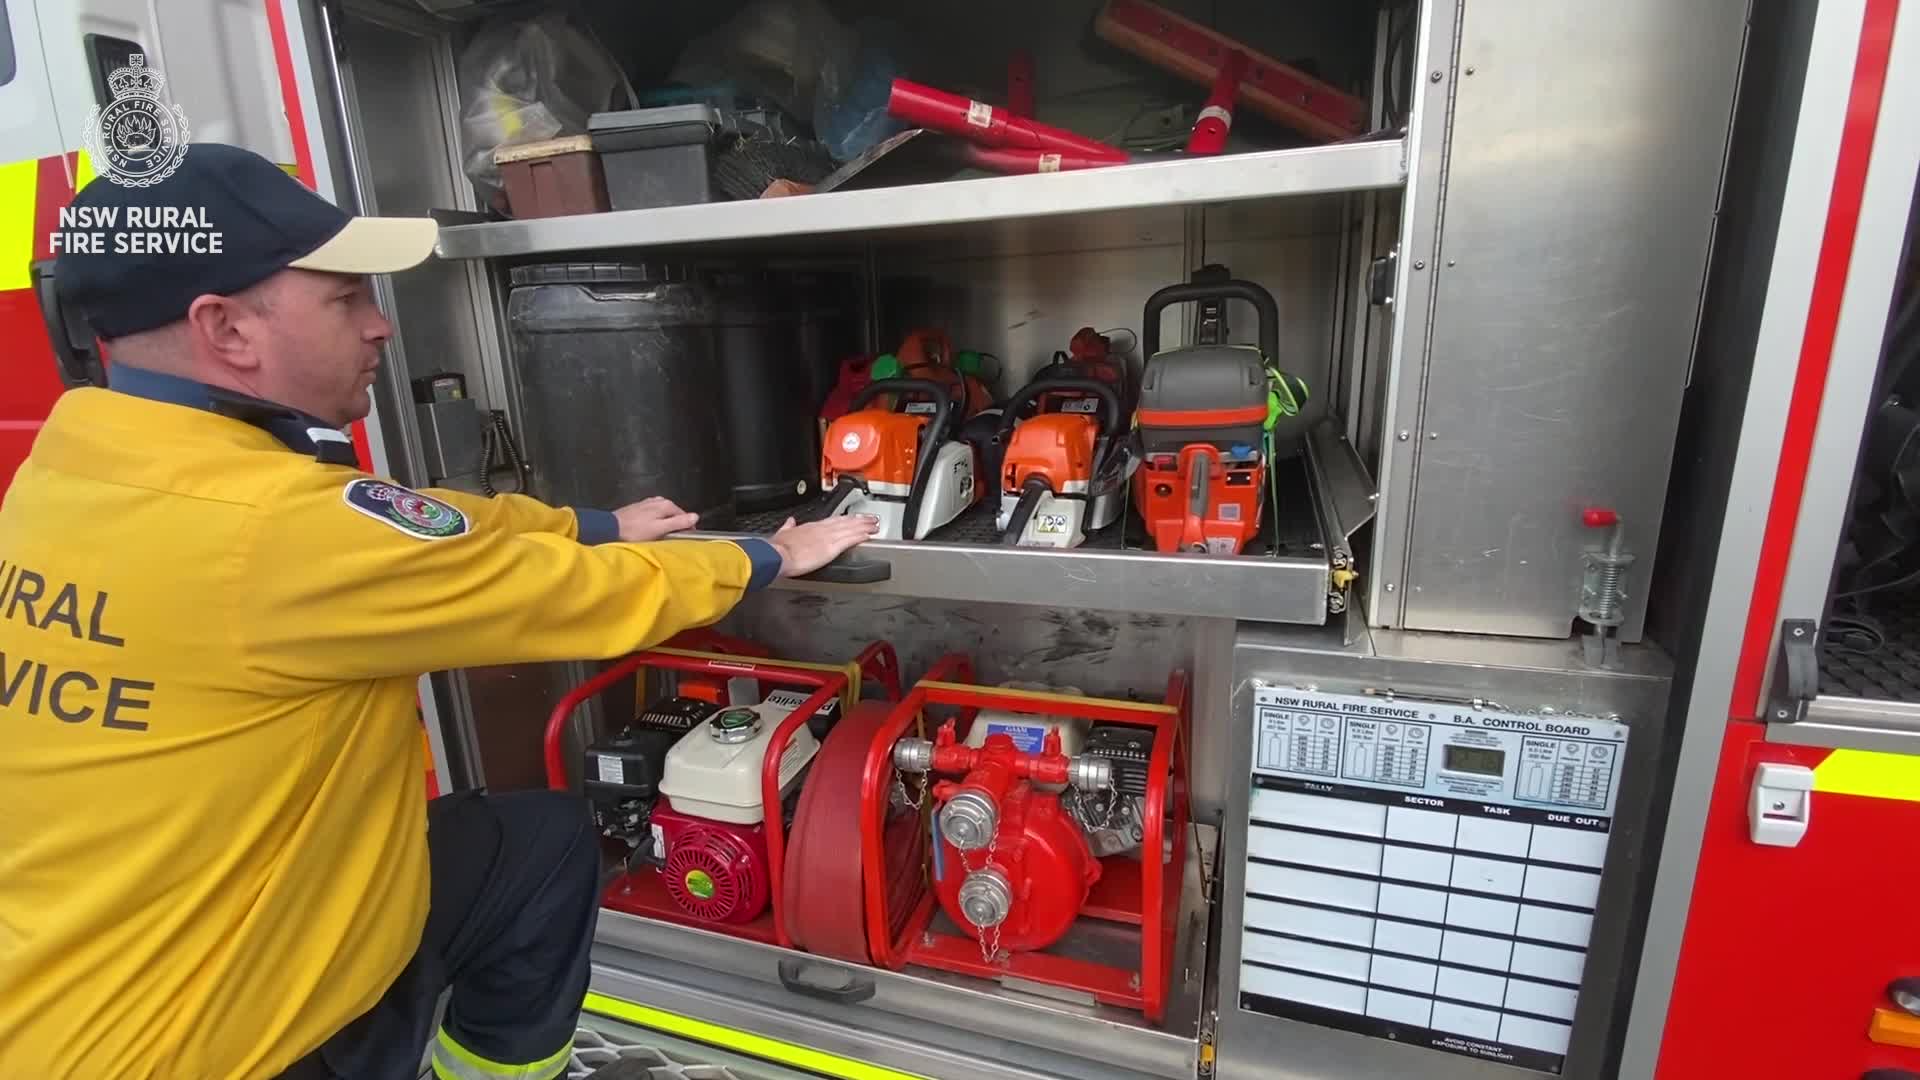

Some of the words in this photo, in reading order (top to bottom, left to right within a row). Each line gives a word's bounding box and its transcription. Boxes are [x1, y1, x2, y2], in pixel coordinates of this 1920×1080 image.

[1275, 697, 1300, 706] NSW
[1302, 699, 1340, 711] RURAL
[1343, 703, 1368, 713] FIRE
[1370, 705, 1420, 719] SERVICE
[1453, 714, 1476, 725] B.A.
[1483, 717, 1542, 731] CONTROL
[1545, 724, 1590, 736] BOARD
[1304, 782, 1333, 792] TALLY
[1404, 796, 1444, 807] SECTOR
[1483, 806, 1511, 816] TASK
[1548, 814, 1570, 823] DUE
[1575, 817, 1599, 826] OUT
